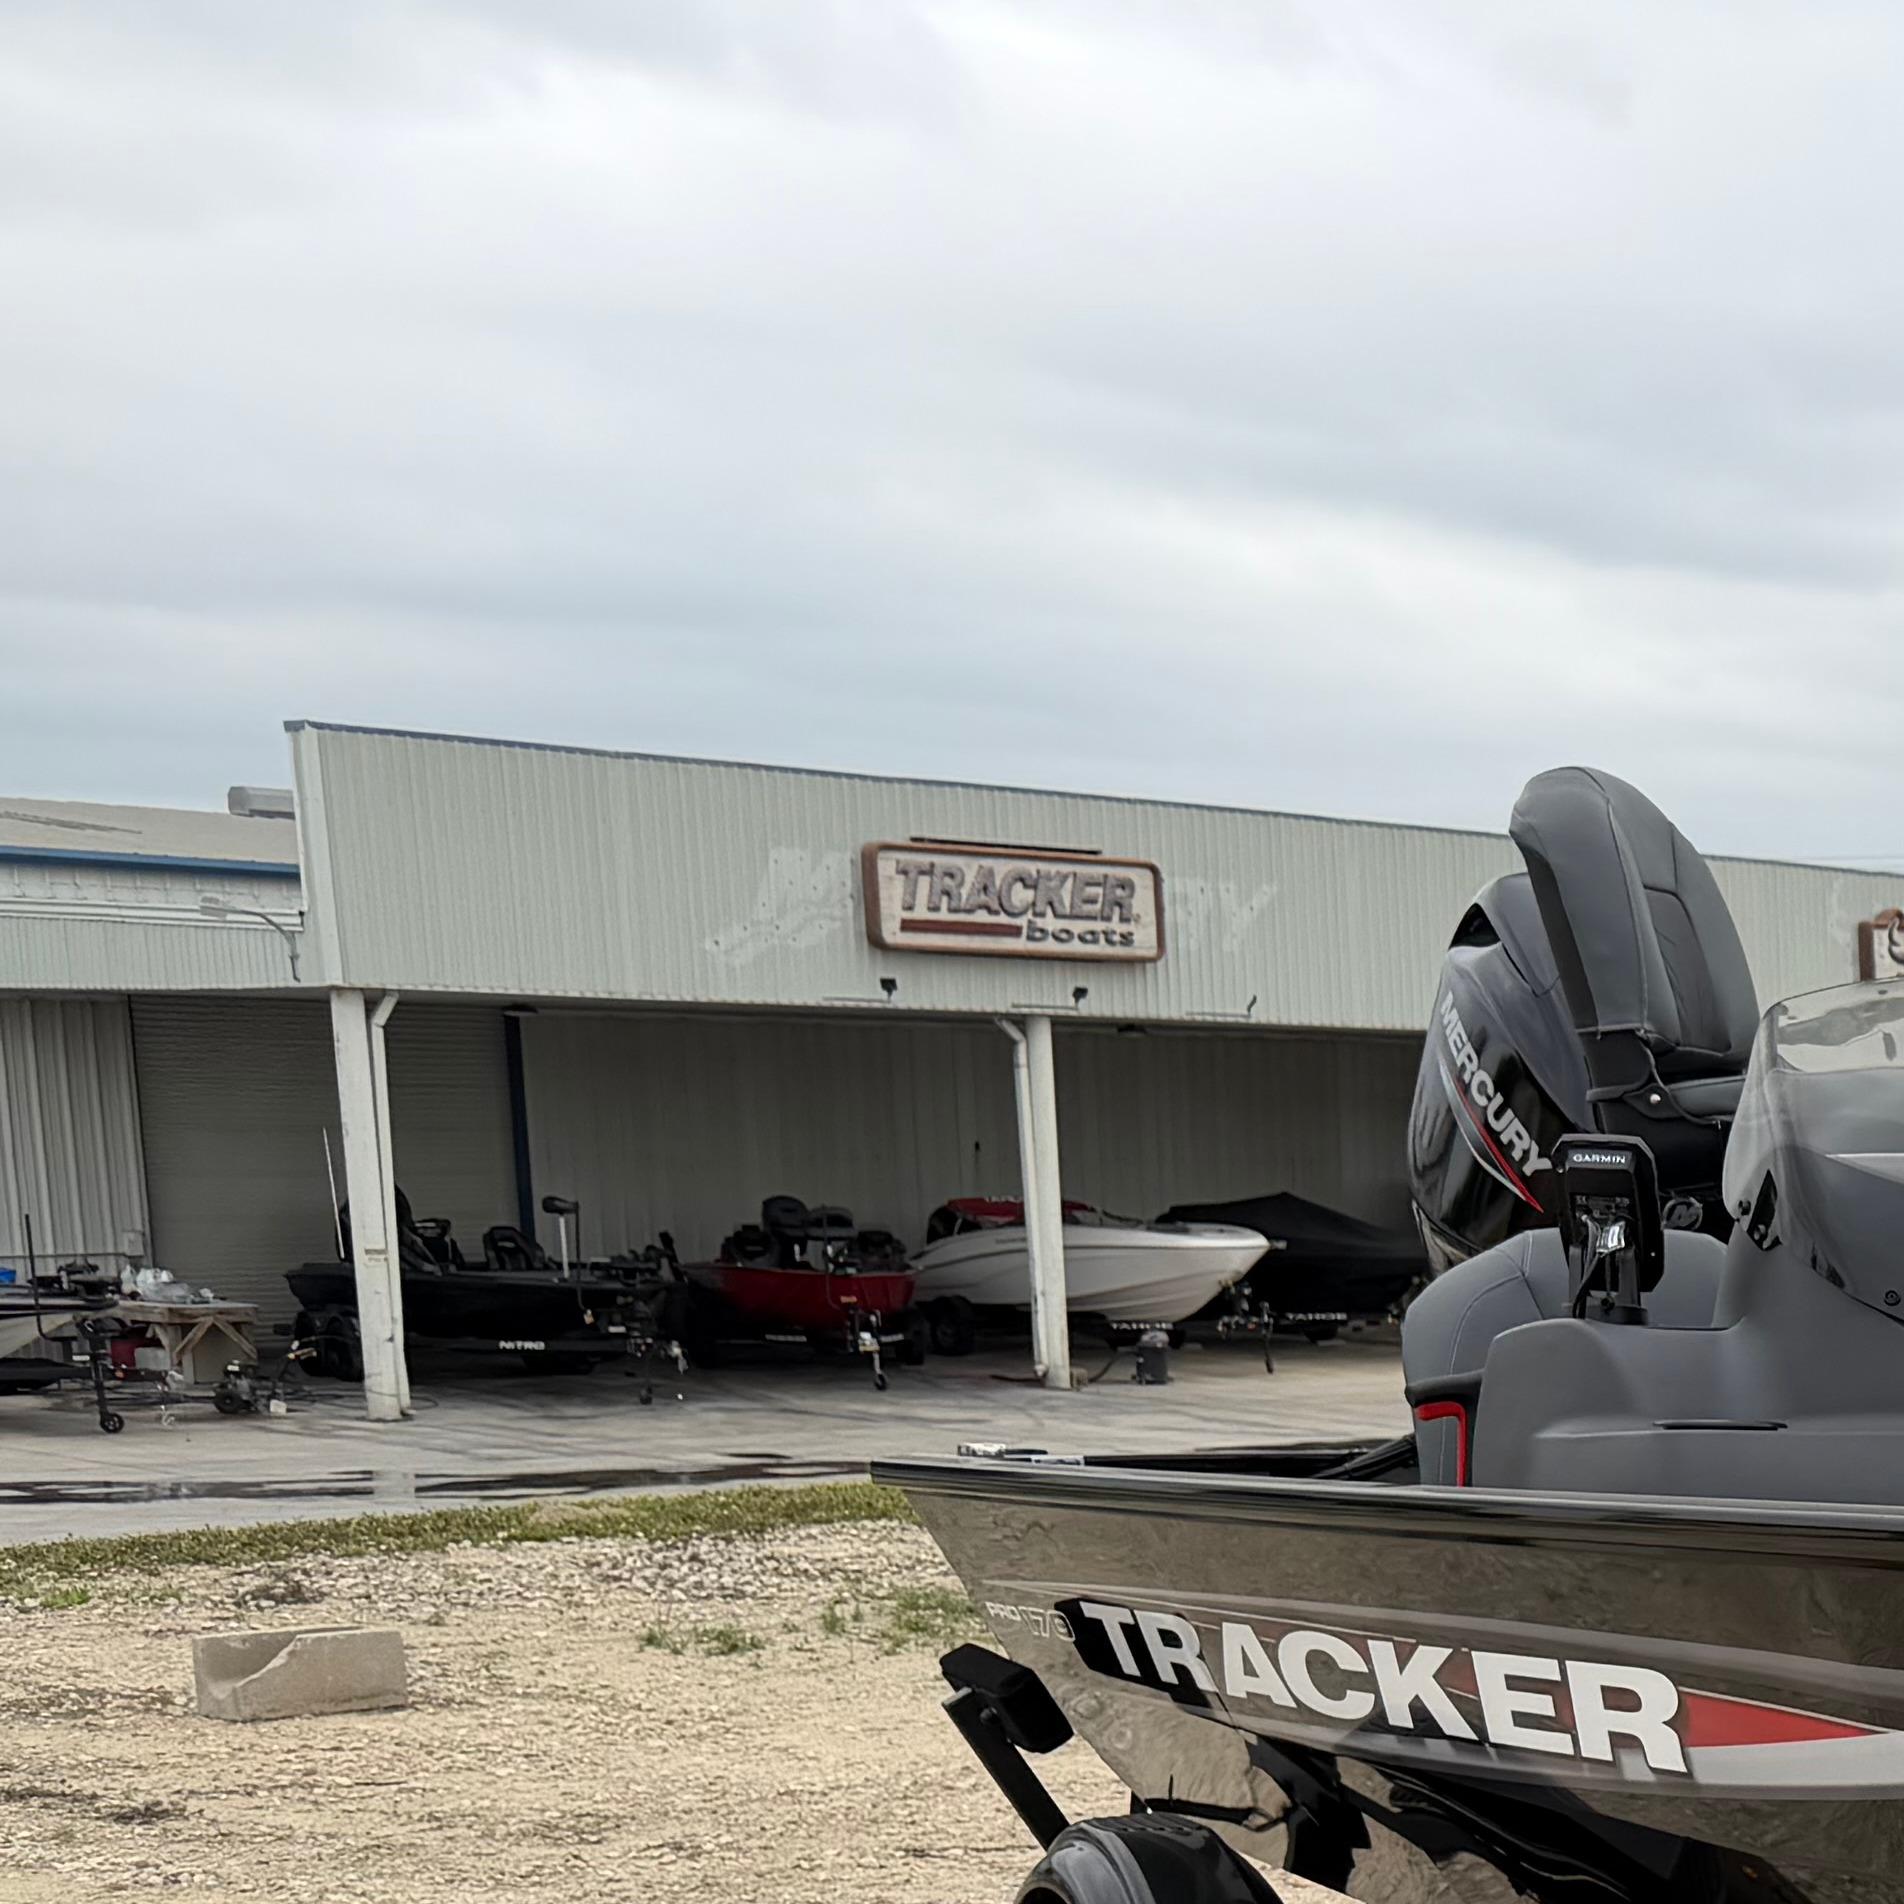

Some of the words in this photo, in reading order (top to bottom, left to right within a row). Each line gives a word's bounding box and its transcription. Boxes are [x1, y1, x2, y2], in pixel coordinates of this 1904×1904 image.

[896, 859, 1137, 924] TRACKER
[1026, 919, 1135, 947] boats
[1440, 990, 1552, 1177] MERCURY
[1572, 1153, 1627, 1165] GARMIN
[985, 1601, 1022, 1623] PRO
[1079, 1600, 1688, 1774] TRACKER
